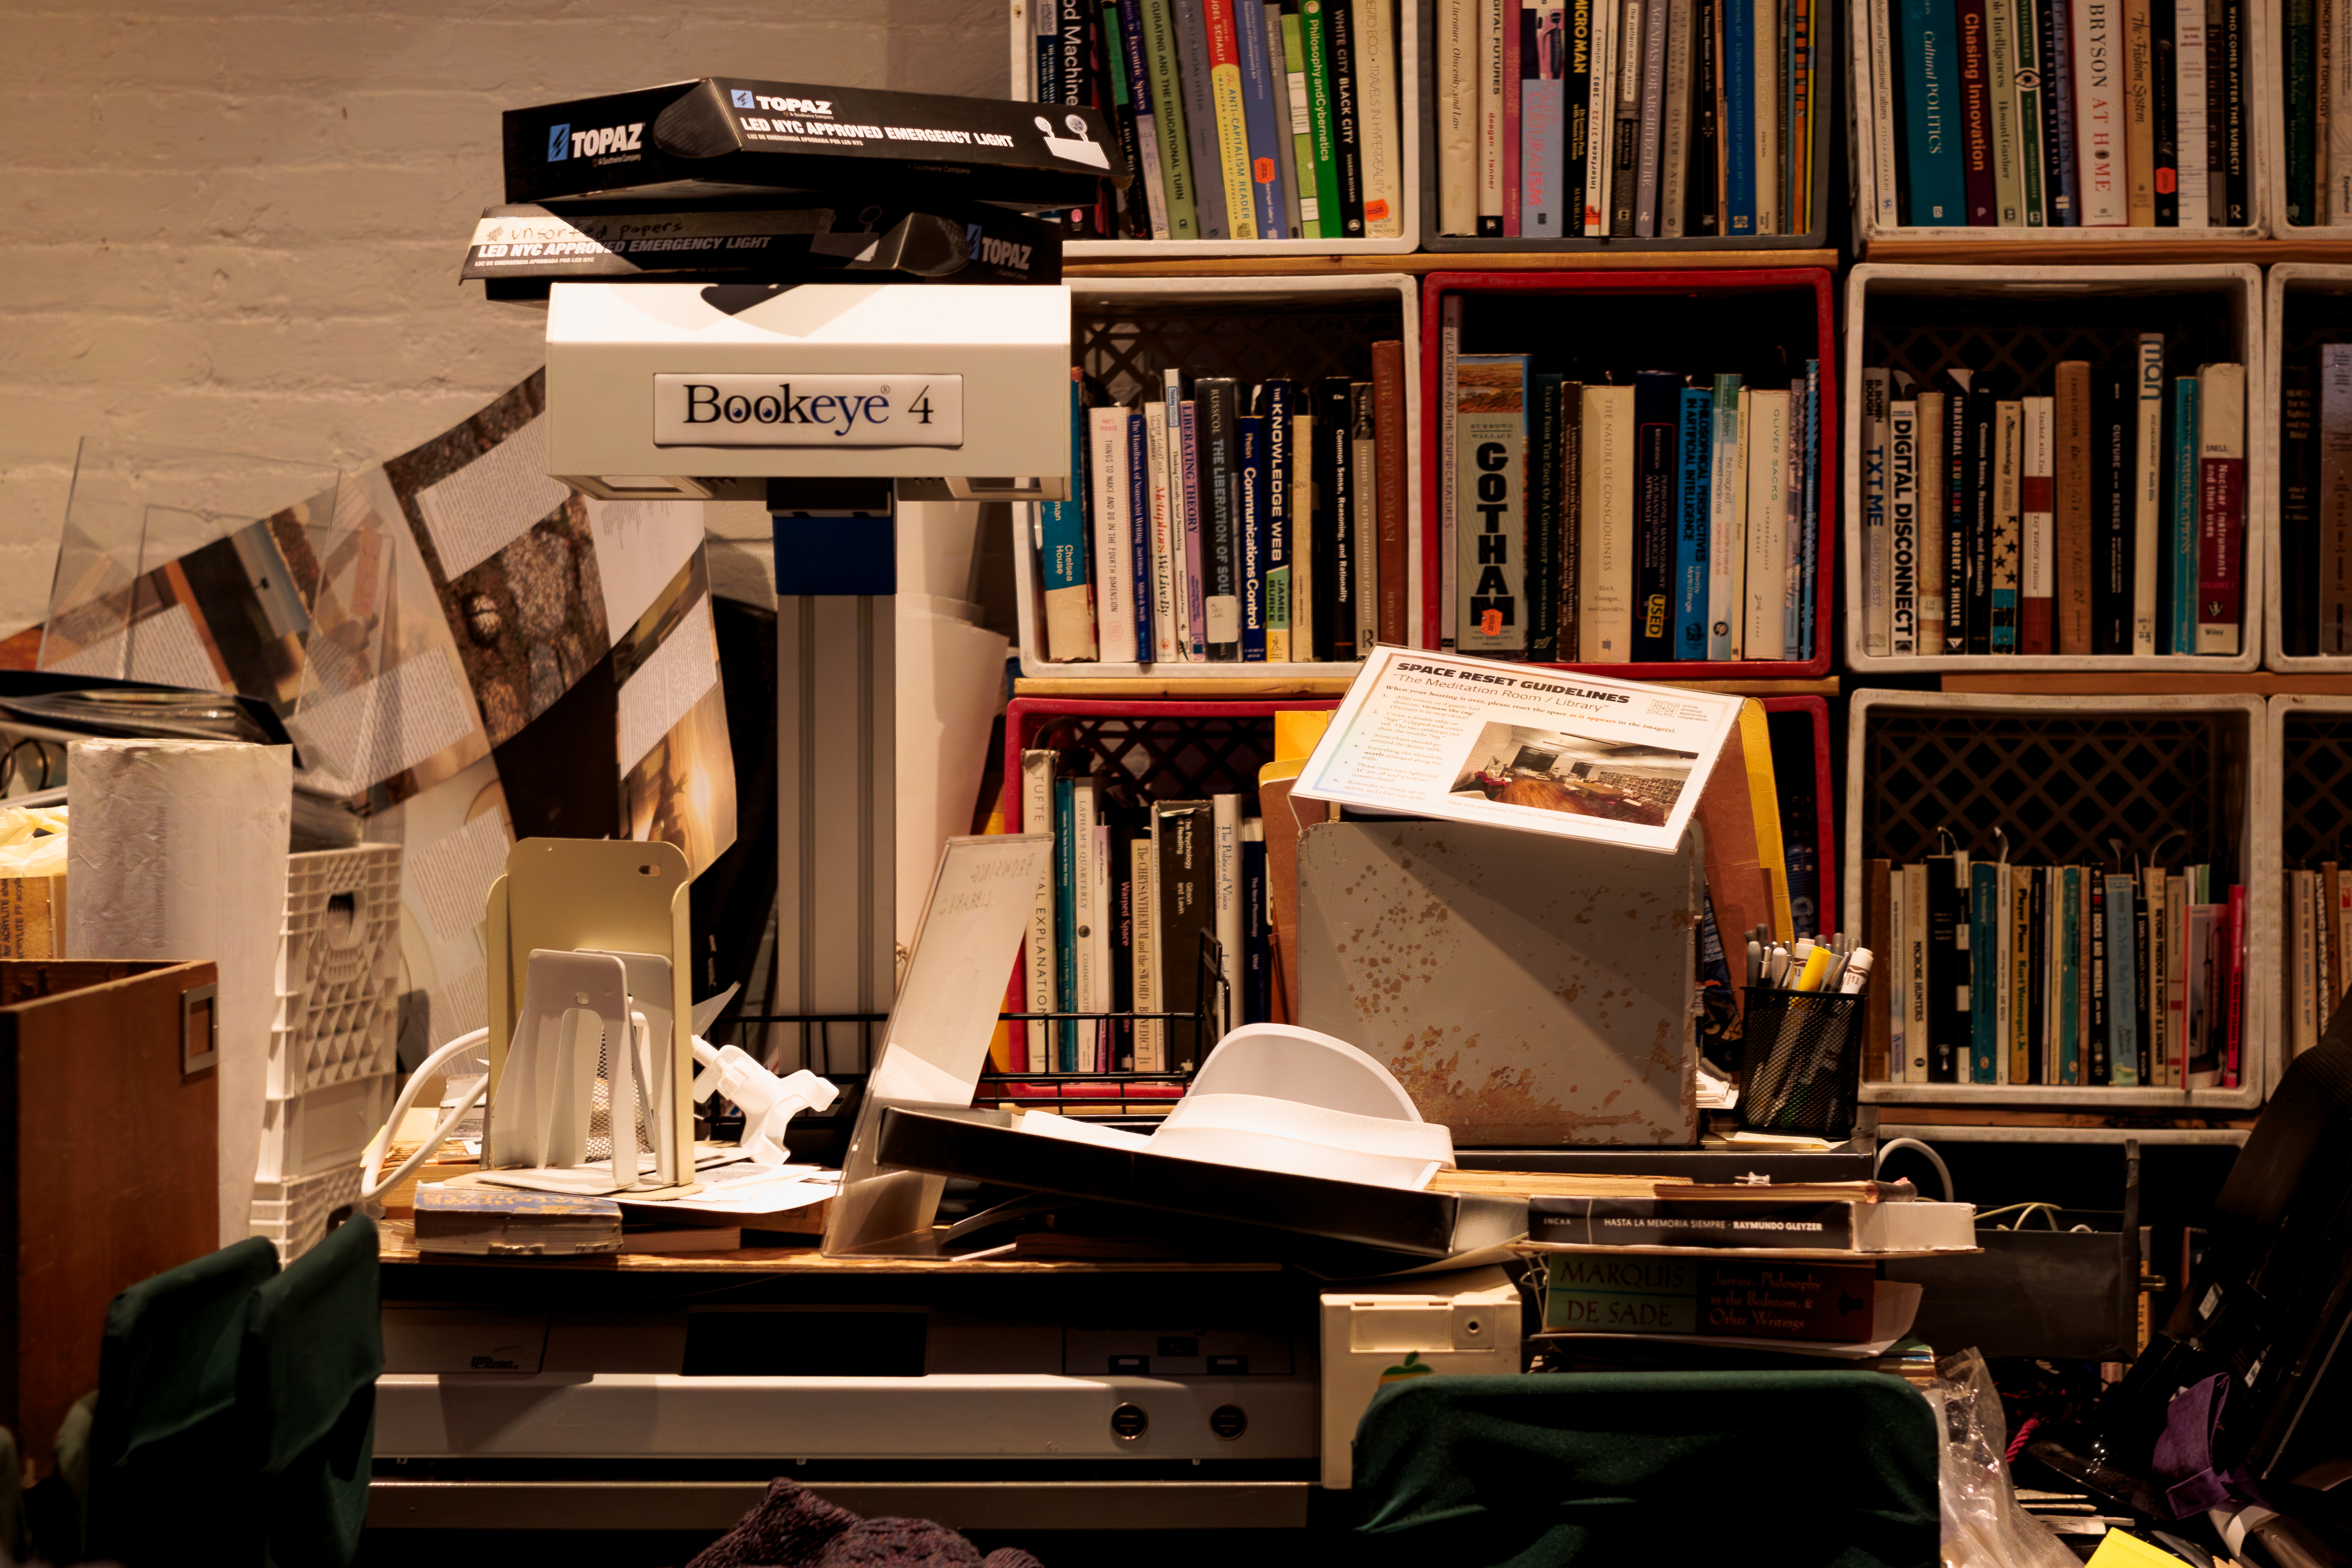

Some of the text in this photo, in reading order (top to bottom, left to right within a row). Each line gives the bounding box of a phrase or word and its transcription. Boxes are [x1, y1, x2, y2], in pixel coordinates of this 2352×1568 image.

[1214, 24, 1225, 62] SCHALIT
[1450, 1, 1460, 45] Literature,
[1063, 27, 1083, 106] Machine
[1334, 10, 1354, 144] WHITE CITY BLACK CITY
[1451, 48, 1461, 92] Obscenity,
[1573, 40, 1588, 73] MAN
[2125, 12, 2149, 123] The Fashion System
[2228, 6, 2239, 125] WHO COMES AFTER THE
[756, 96, 832, 114] TOPAZ
[1151, 1, 1185, 200] CURATING AND THE EDUCATIONAL TURN
[1642, 6, 1662, 186] AGENDAS FOR ARCHITECTURE
[1924, 31, 1941, 154] Cultural POLITICS
[1964, 13, 1985, 171] Chasing Innovation
[2089, 5, 2111, 192] BRYSON AT HOME
[571, 122, 644, 158] TOPAZ
[740, 117, 1014, 147] LED NYC APPROVED EMERGENCY LIGHT
[1527, 92, 1544, 205] CULTURALISM
[1227, 90, 1250, 219] ANTI-CAPITALISM READER
[478, 237, 772, 258] LED NYC APPROVED EMERGENCY LIGHT
[981, 236, 1032, 270] TOPAZ
[909, 386, 934, 424] 4
[1952, 396, 1963, 456] IRRATIONAL
[1105, 440, 1113, 463] THINGS
[1106, 465, 1114, 474] TO
[1181, 405, 1198, 534] LIBERATING THEORY
[1106, 476, 1115, 495] MAKE
[1210, 388, 1228, 562] RUSSCOL THE LIBERATION OF
[1271, 387, 1283, 562] THE KNOWLEDGE WEB
[1866, 446, 1883, 527] TXT ME
[1107, 496, 1115, 509] AND
[1107, 512, 1115, 521] DO
[2205, 464, 2217, 538] and their uses
[2216, 464, 2229, 577] Nuclear Instruments
[1108, 532, 1116, 545] THE
[1243, 467, 1260, 629] Communications Control
[1894, 420, 1913, 635] DIGITAL DISCONNECT
[1055, 545, 1065, 575] House
[1064, 545, 1075, 582] Chelsea
[1108, 547, 1117, 574] FOURTH
[1152, 486, 1170, 617] Metaphors We Live By
[1951, 532, 1962, 571] ROBERT
[1109, 576, 1119, 612] DIMENSION
[1951, 574, 1961, 584] J.
[1267, 580, 1276, 622] BURKE
[1276, 579, 1285, 622] JAMES
[1649, 595, 1663, 635] USED
[1950, 587, 1961, 627] SHILLER
[1397, 663, 1630, 704] SPACE RESET GUIDELINES
[1425, 678, 1499, 695] Meditation
[1503, 689, 1542, 703] Room
[1430, 691, 1458, 700] hosting
[1643, 724, 1676, 733] image(s).
[1221, 824, 1232, 842] The
[1221, 844, 1233, 872] Politics
[1119, 881, 1131, 947] Warped Space
[1222, 885, 1233, 910] Vision
[1136, 846, 1149, 1000] The CHRYSANTHEMUM and the SWORD
[1914, 941, 1923, 1022] MICROBE HUNTERS
[1605, 1217, 1632, 1227] HASTA
[1647, 1219, 1688, 1228] MEMORIA
[1690, 1220, 1726, 1229] SIEMPRE
[1733, 1221, 1784, 1230] RAYMUNDO
[1786, 1223, 1823, 1231] GLEYZER
[1560, 1260, 1684, 1288] MARQUIS
[1568, 1300, 1673, 1327] DE SADE
